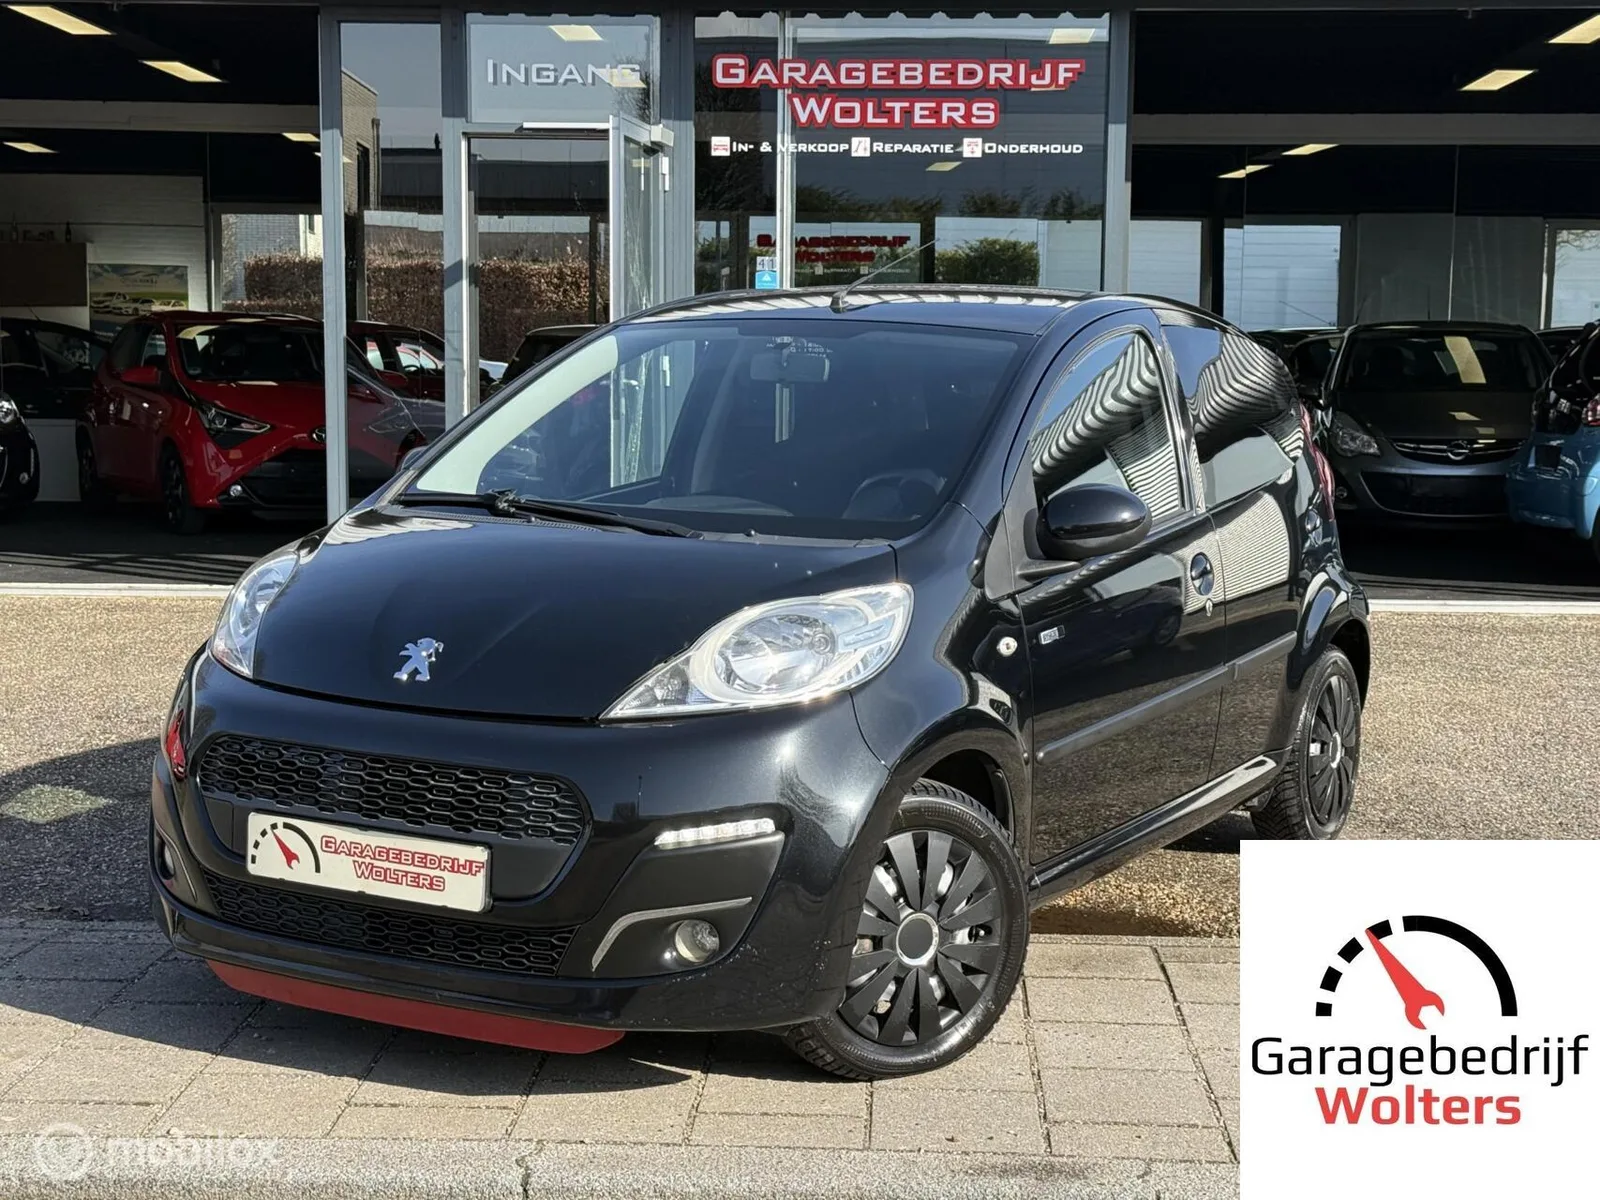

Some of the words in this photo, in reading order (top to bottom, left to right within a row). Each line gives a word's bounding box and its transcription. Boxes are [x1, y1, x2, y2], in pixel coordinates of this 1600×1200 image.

[487, 58, 642, 85] INGANG
[713, 55, 1084, 89] GARAGEBEDRIJF
[790, 94, 998, 127] WOLTERS
[759, 141, 773, 153] &
[872, 142, 954, 154] REPARATIE
[984, 142, 1084, 154] ONDERHOUD
[320, 835, 485, 876] GARAGEBEDRIJF
[352, 860, 446, 892] WOLTERS
